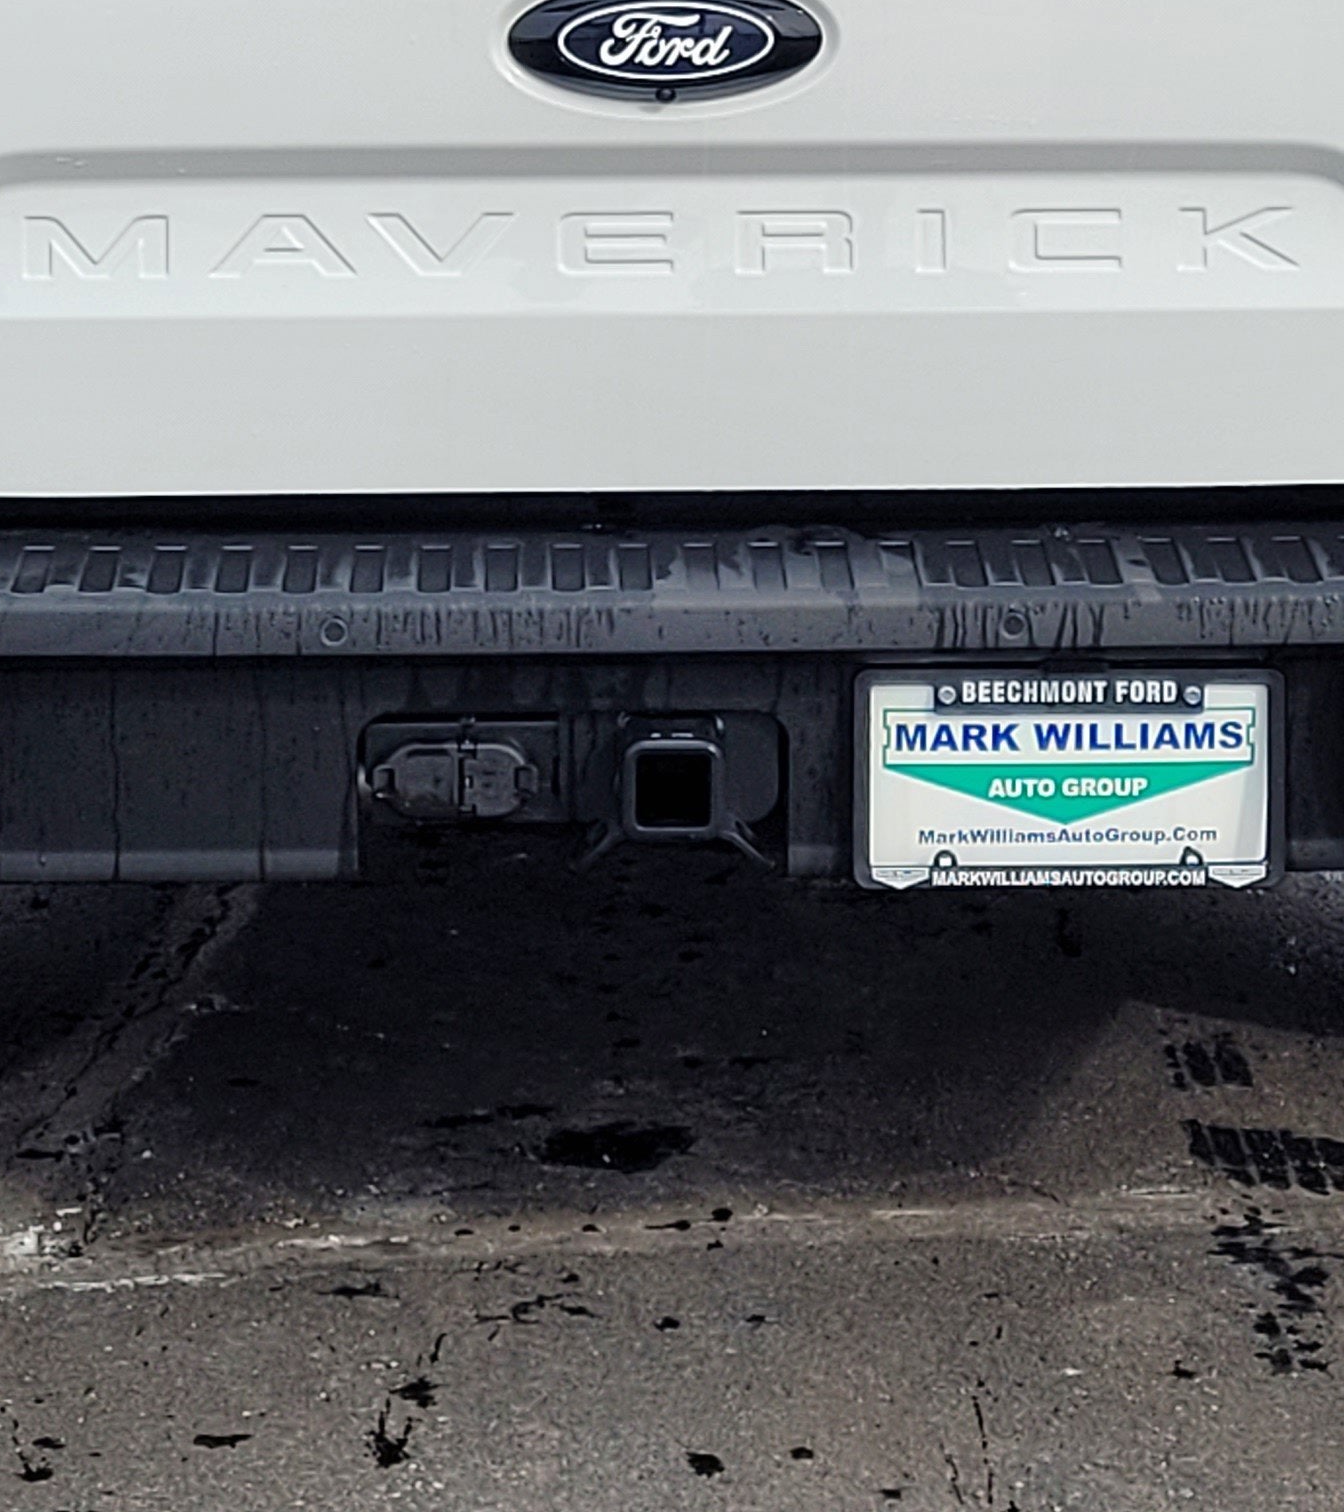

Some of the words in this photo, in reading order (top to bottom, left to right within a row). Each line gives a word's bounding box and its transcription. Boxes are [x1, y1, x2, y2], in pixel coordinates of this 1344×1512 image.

[599, 13, 732, 66] Ford
[22, 207, 1301, 280] MAVERICK
[962, 681, 1106, 704] BEECHMONT
[1115, 680, 1177, 703] FORD
[895, 723, 1019, 752] MARK
[1034, 721, 1243, 751] WILLIAMS
[988, 779, 1055, 798] AUTO
[1062, 777, 1148, 797] GROUP
[918, 826, 1217, 845] MarkWilliamsAutoGroup.Com
[932, 870, 1206, 887] MARKWILLIAMSAUTOGROUP.COM
